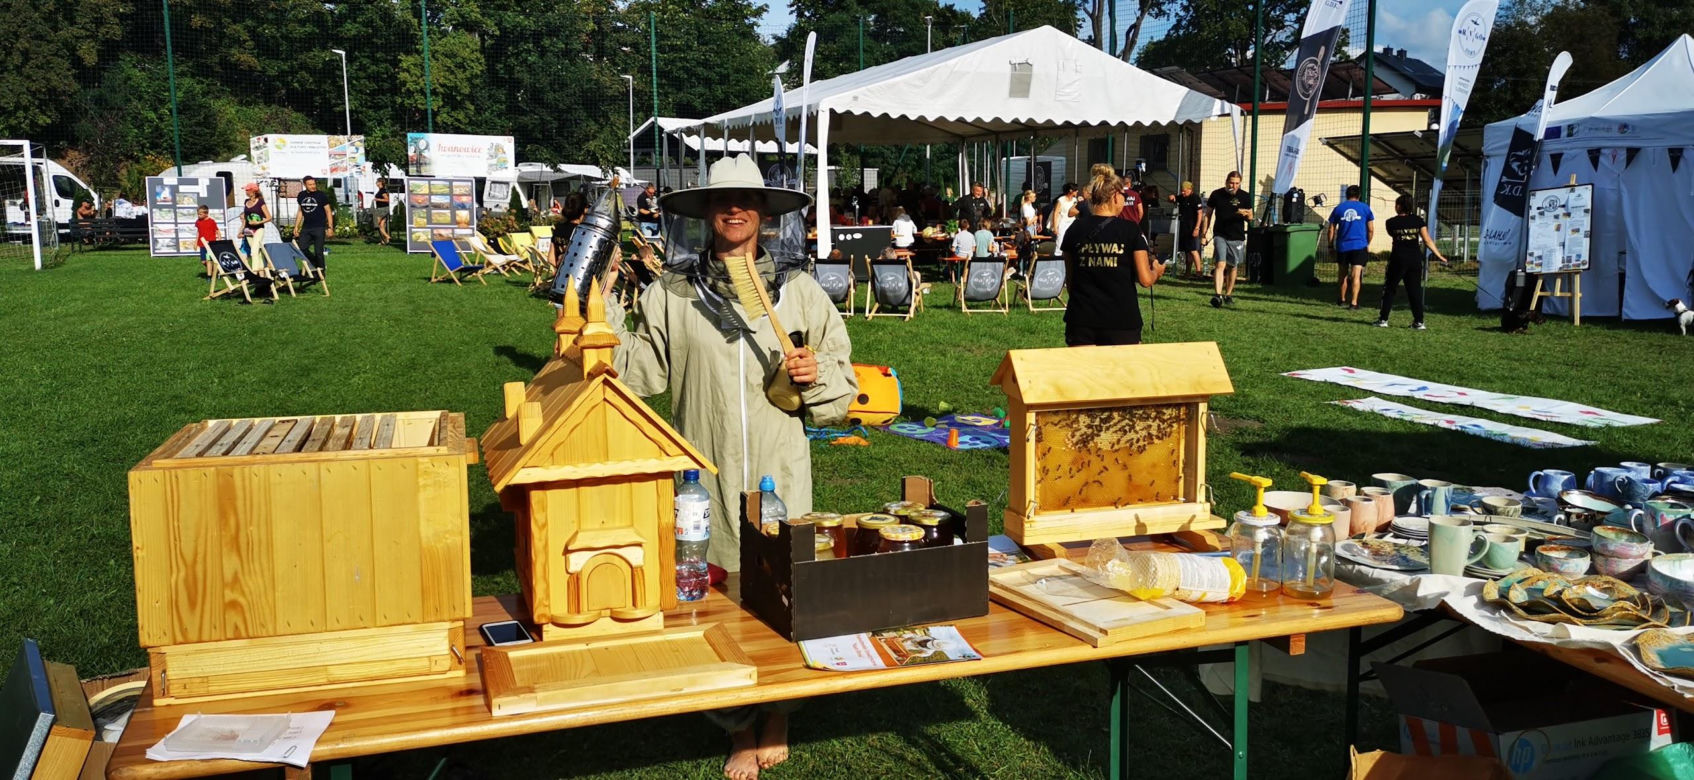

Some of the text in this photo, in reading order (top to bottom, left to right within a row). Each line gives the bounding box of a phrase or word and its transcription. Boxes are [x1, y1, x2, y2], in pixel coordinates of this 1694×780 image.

[1088, 256, 1118, 267] NAMI
[1588, 733, 1630, 746] Advantage
[1511, 739, 1531, 775] hp
